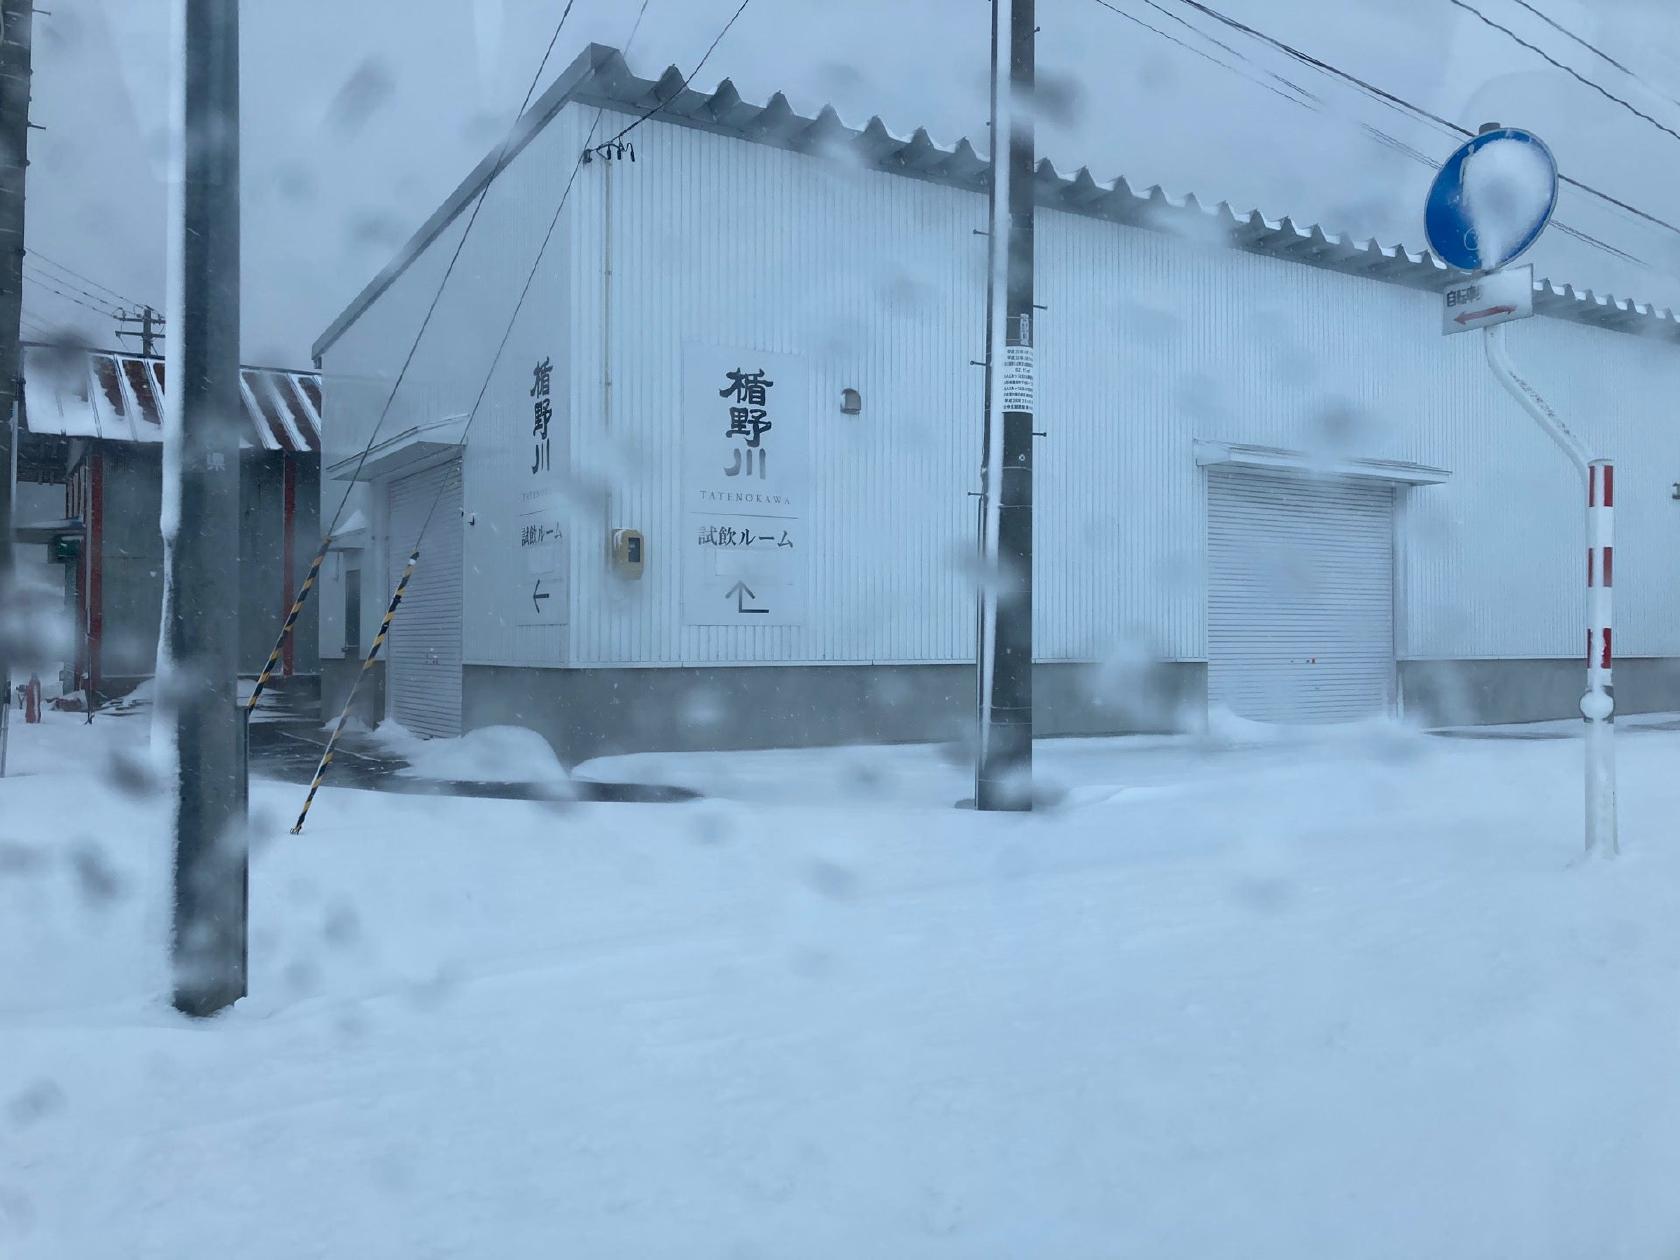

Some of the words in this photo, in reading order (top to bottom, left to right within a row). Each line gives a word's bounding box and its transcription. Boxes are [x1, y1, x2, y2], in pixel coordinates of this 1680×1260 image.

[530, 355, 554, 475] 楯野川
[719, 367, 774, 480] 楯野川
[698, 490, 791, 505] TATENOKAWA
[698, 525, 793, 548] 試飲ルーム
